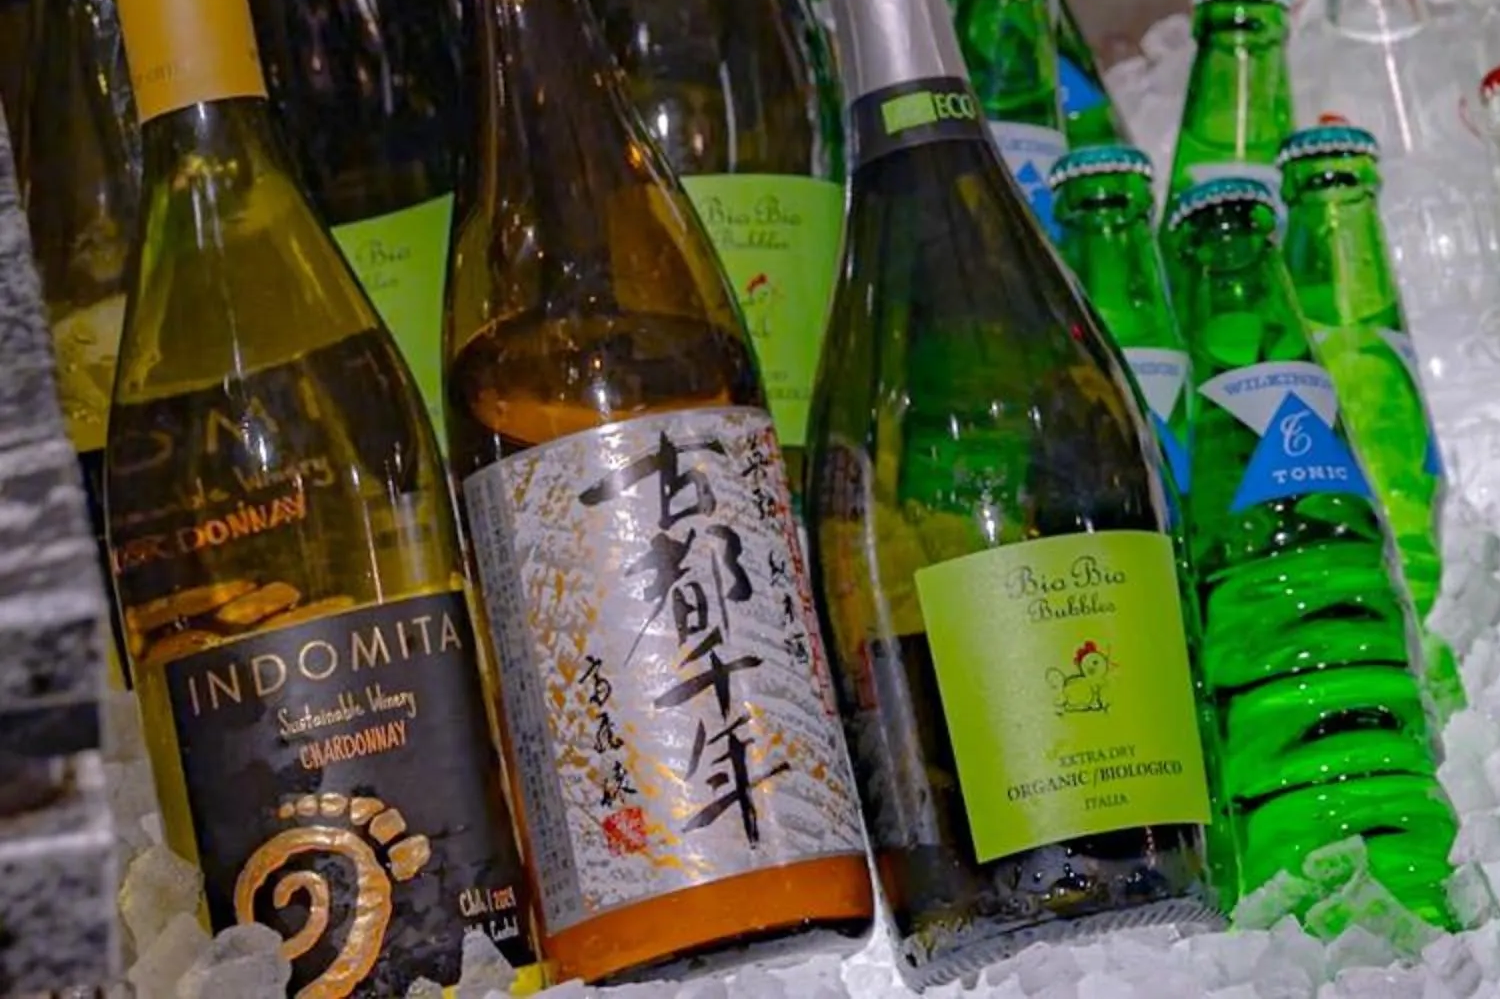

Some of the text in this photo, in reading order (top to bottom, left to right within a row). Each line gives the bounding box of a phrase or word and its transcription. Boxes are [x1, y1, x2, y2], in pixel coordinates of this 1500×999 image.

[935, 91, 977, 120] ECO
[1271, 465, 1348, 485] TONIC
[1006, 555, 1126, 600] Bio Bio
[1027, 592, 1118, 624] Bubbles
[188, 612, 462, 717] INDOMITA
[277, 682, 417, 737] Sustainable Winery
[300, 719, 406, 770] CHARDONNAY
[1007, 770, 1090, 803] ORGANIC
[1084, 791, 1130, 811] ITALIA
